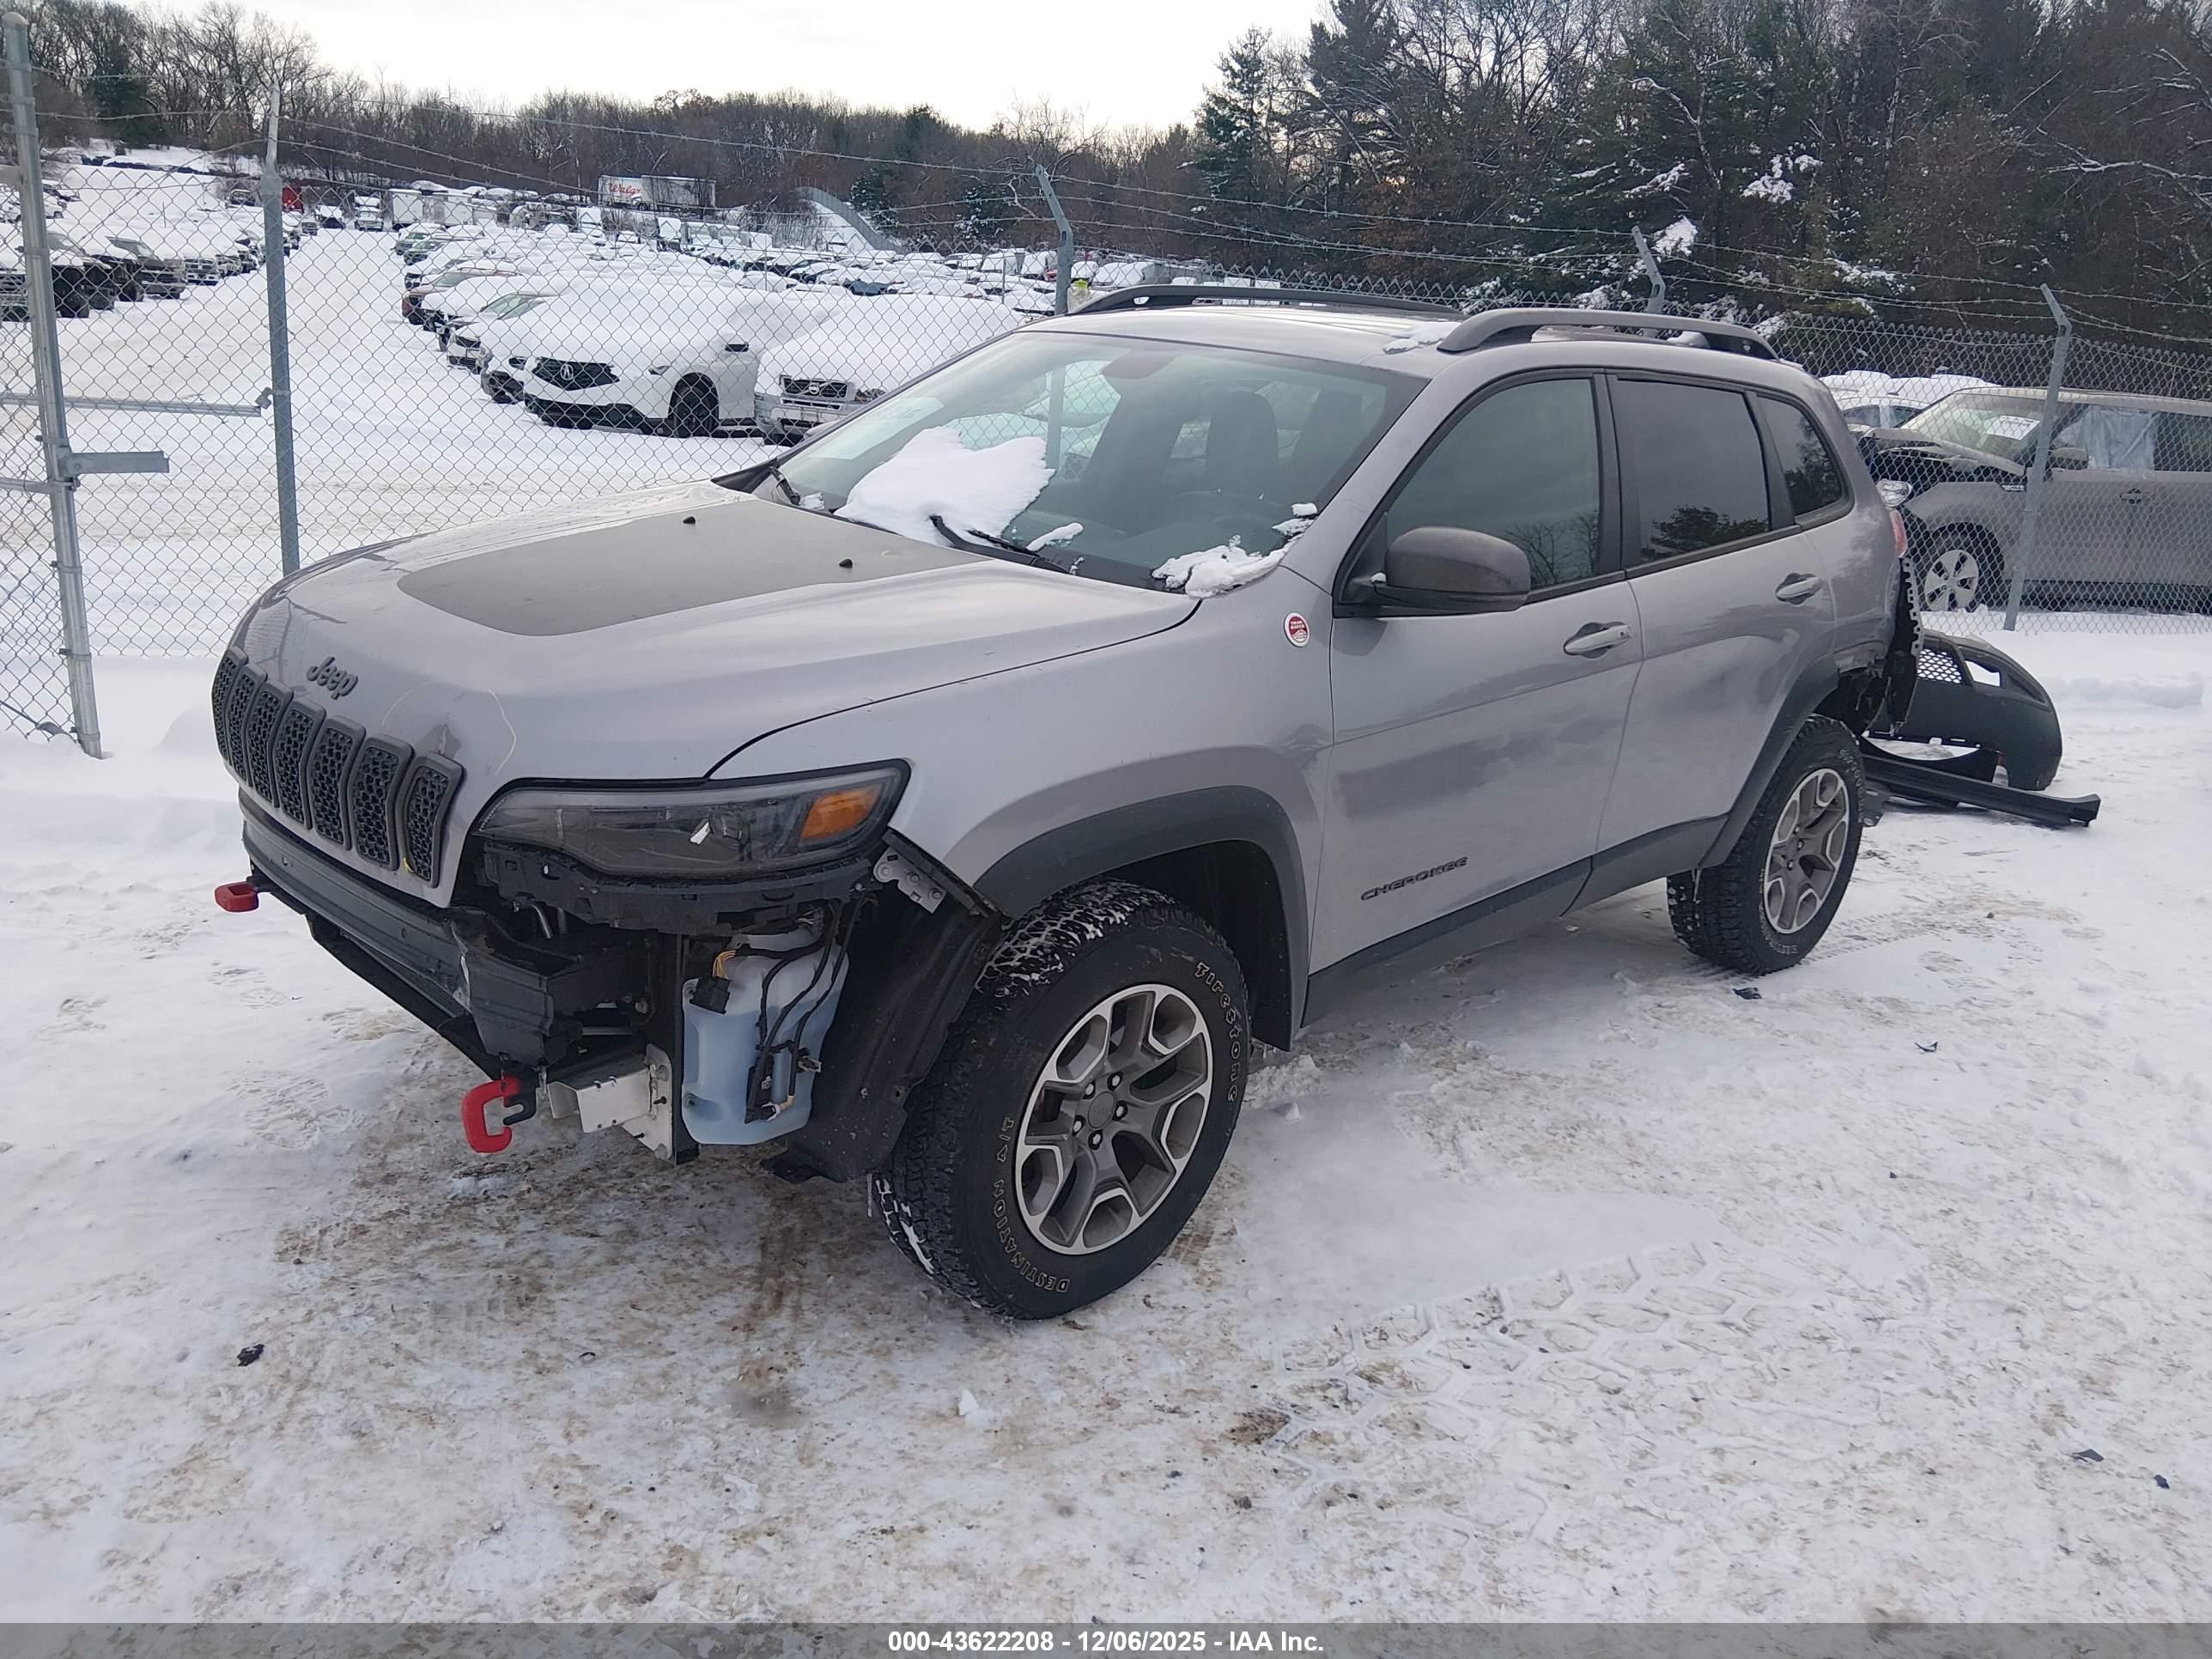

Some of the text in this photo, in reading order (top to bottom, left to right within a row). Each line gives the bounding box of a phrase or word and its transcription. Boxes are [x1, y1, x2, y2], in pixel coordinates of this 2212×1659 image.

[307, 656, 358, 700] Jeep
[1360, 856, 1468, 901] CHEROKEE
[993, 1179, 1070, 1293] DESTINATION
